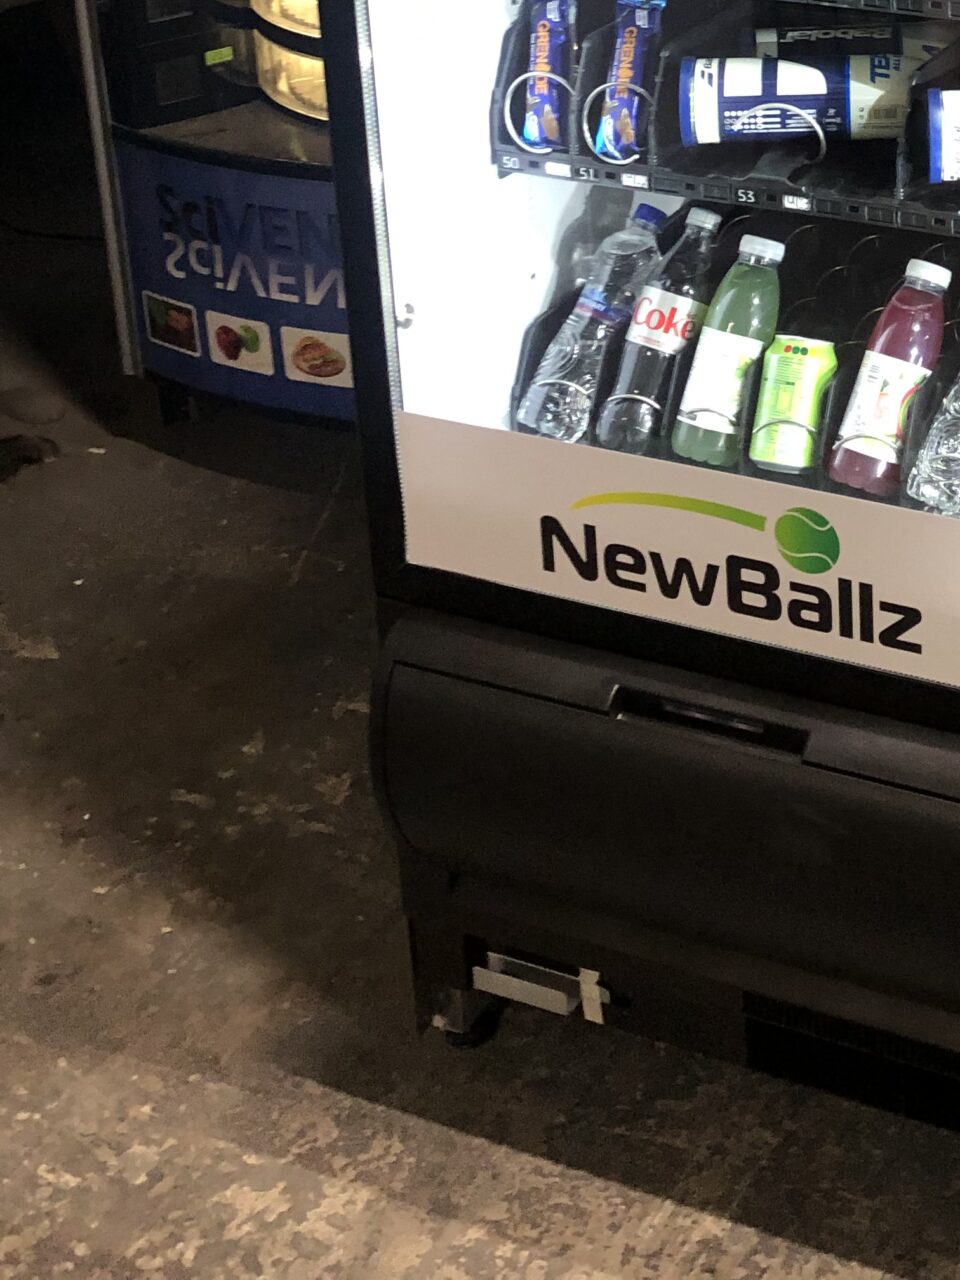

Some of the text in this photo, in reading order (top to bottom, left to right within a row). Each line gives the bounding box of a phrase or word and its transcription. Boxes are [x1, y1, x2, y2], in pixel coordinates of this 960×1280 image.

[502, 156, 520, 169] 50
[579, 167, 596, 180] 51
[737, 189, 755, 203] 53
[633, 296, 695, 341] Coke
[540, 514, 923, 655] NewBallz
